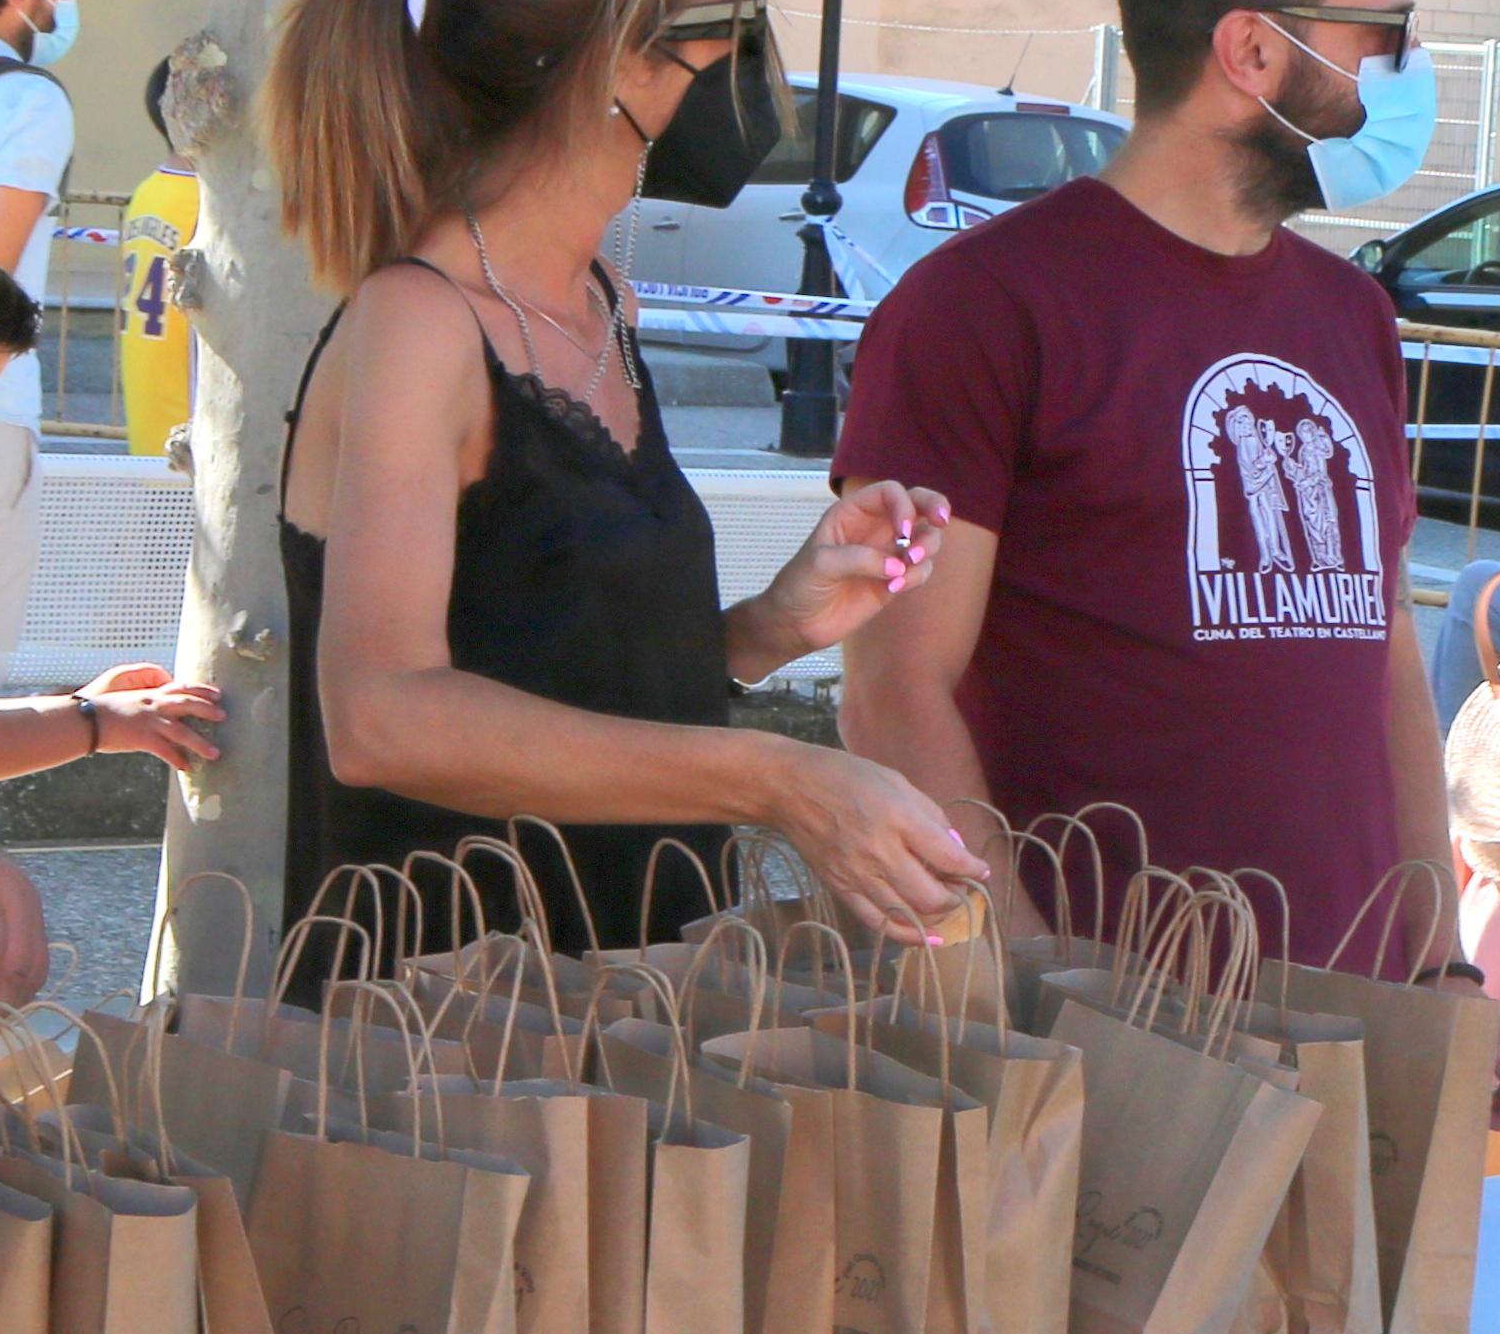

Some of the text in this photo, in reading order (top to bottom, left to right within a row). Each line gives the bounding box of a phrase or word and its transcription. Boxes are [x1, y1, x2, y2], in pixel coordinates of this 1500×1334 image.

[1199, 571, 1387, 626] VILLAMURIEL
[1193, 627, 1235, 641] CUNA
[1238, 628, 1266, 640] DEL
[1268, 626, 1315, 639] TEATRO
[1316, 628, 1332, 639] EN
